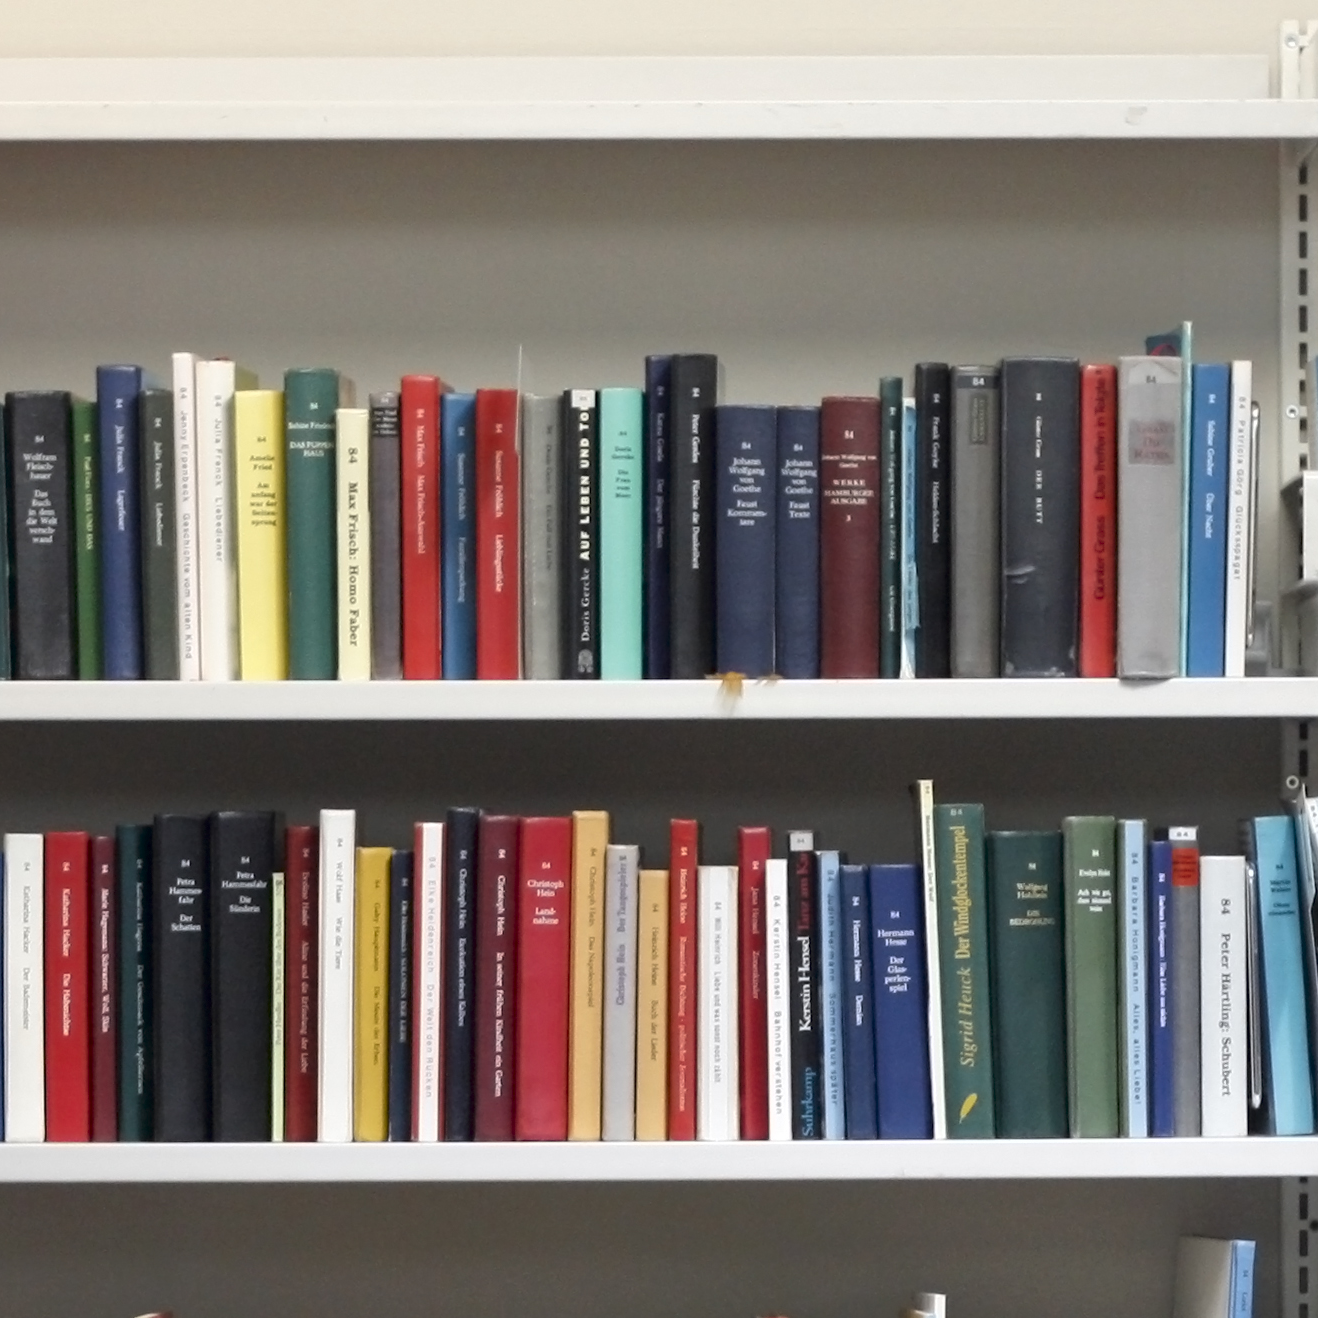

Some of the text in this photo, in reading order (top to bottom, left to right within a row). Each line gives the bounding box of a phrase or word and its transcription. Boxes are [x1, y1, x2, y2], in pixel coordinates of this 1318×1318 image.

[179, 410, 189, 441] Jenny
[180, 444, 191, 502] Erpenbeck
[579, 408, 591, 561] AUF LEBEN UND TO
[182, 513, 192, 573] Geschichte
[348, 447, 360, 646] 84 Max Frisch: Homo Faber
[581, 610, 591, 641] Doris
[495, 875, 506, 914] Christoph
[949, 826, 970, 958] Der Windglockentempel
[496, 917, 506, 936] Hein
[1221, 933, 1231, 969] Peter
[494, 989, 505, 1017] frühen
[797, 936, 812, 1031] Kerstin Hensel
[494, 1019, 504, 1053] Kindheit
[958, 967, 975, 1067] Sigrid Heuck
[1221, 1037, 1232, 1097] Schubert
[801, 1067, 814, 1136] Suhrkamp
